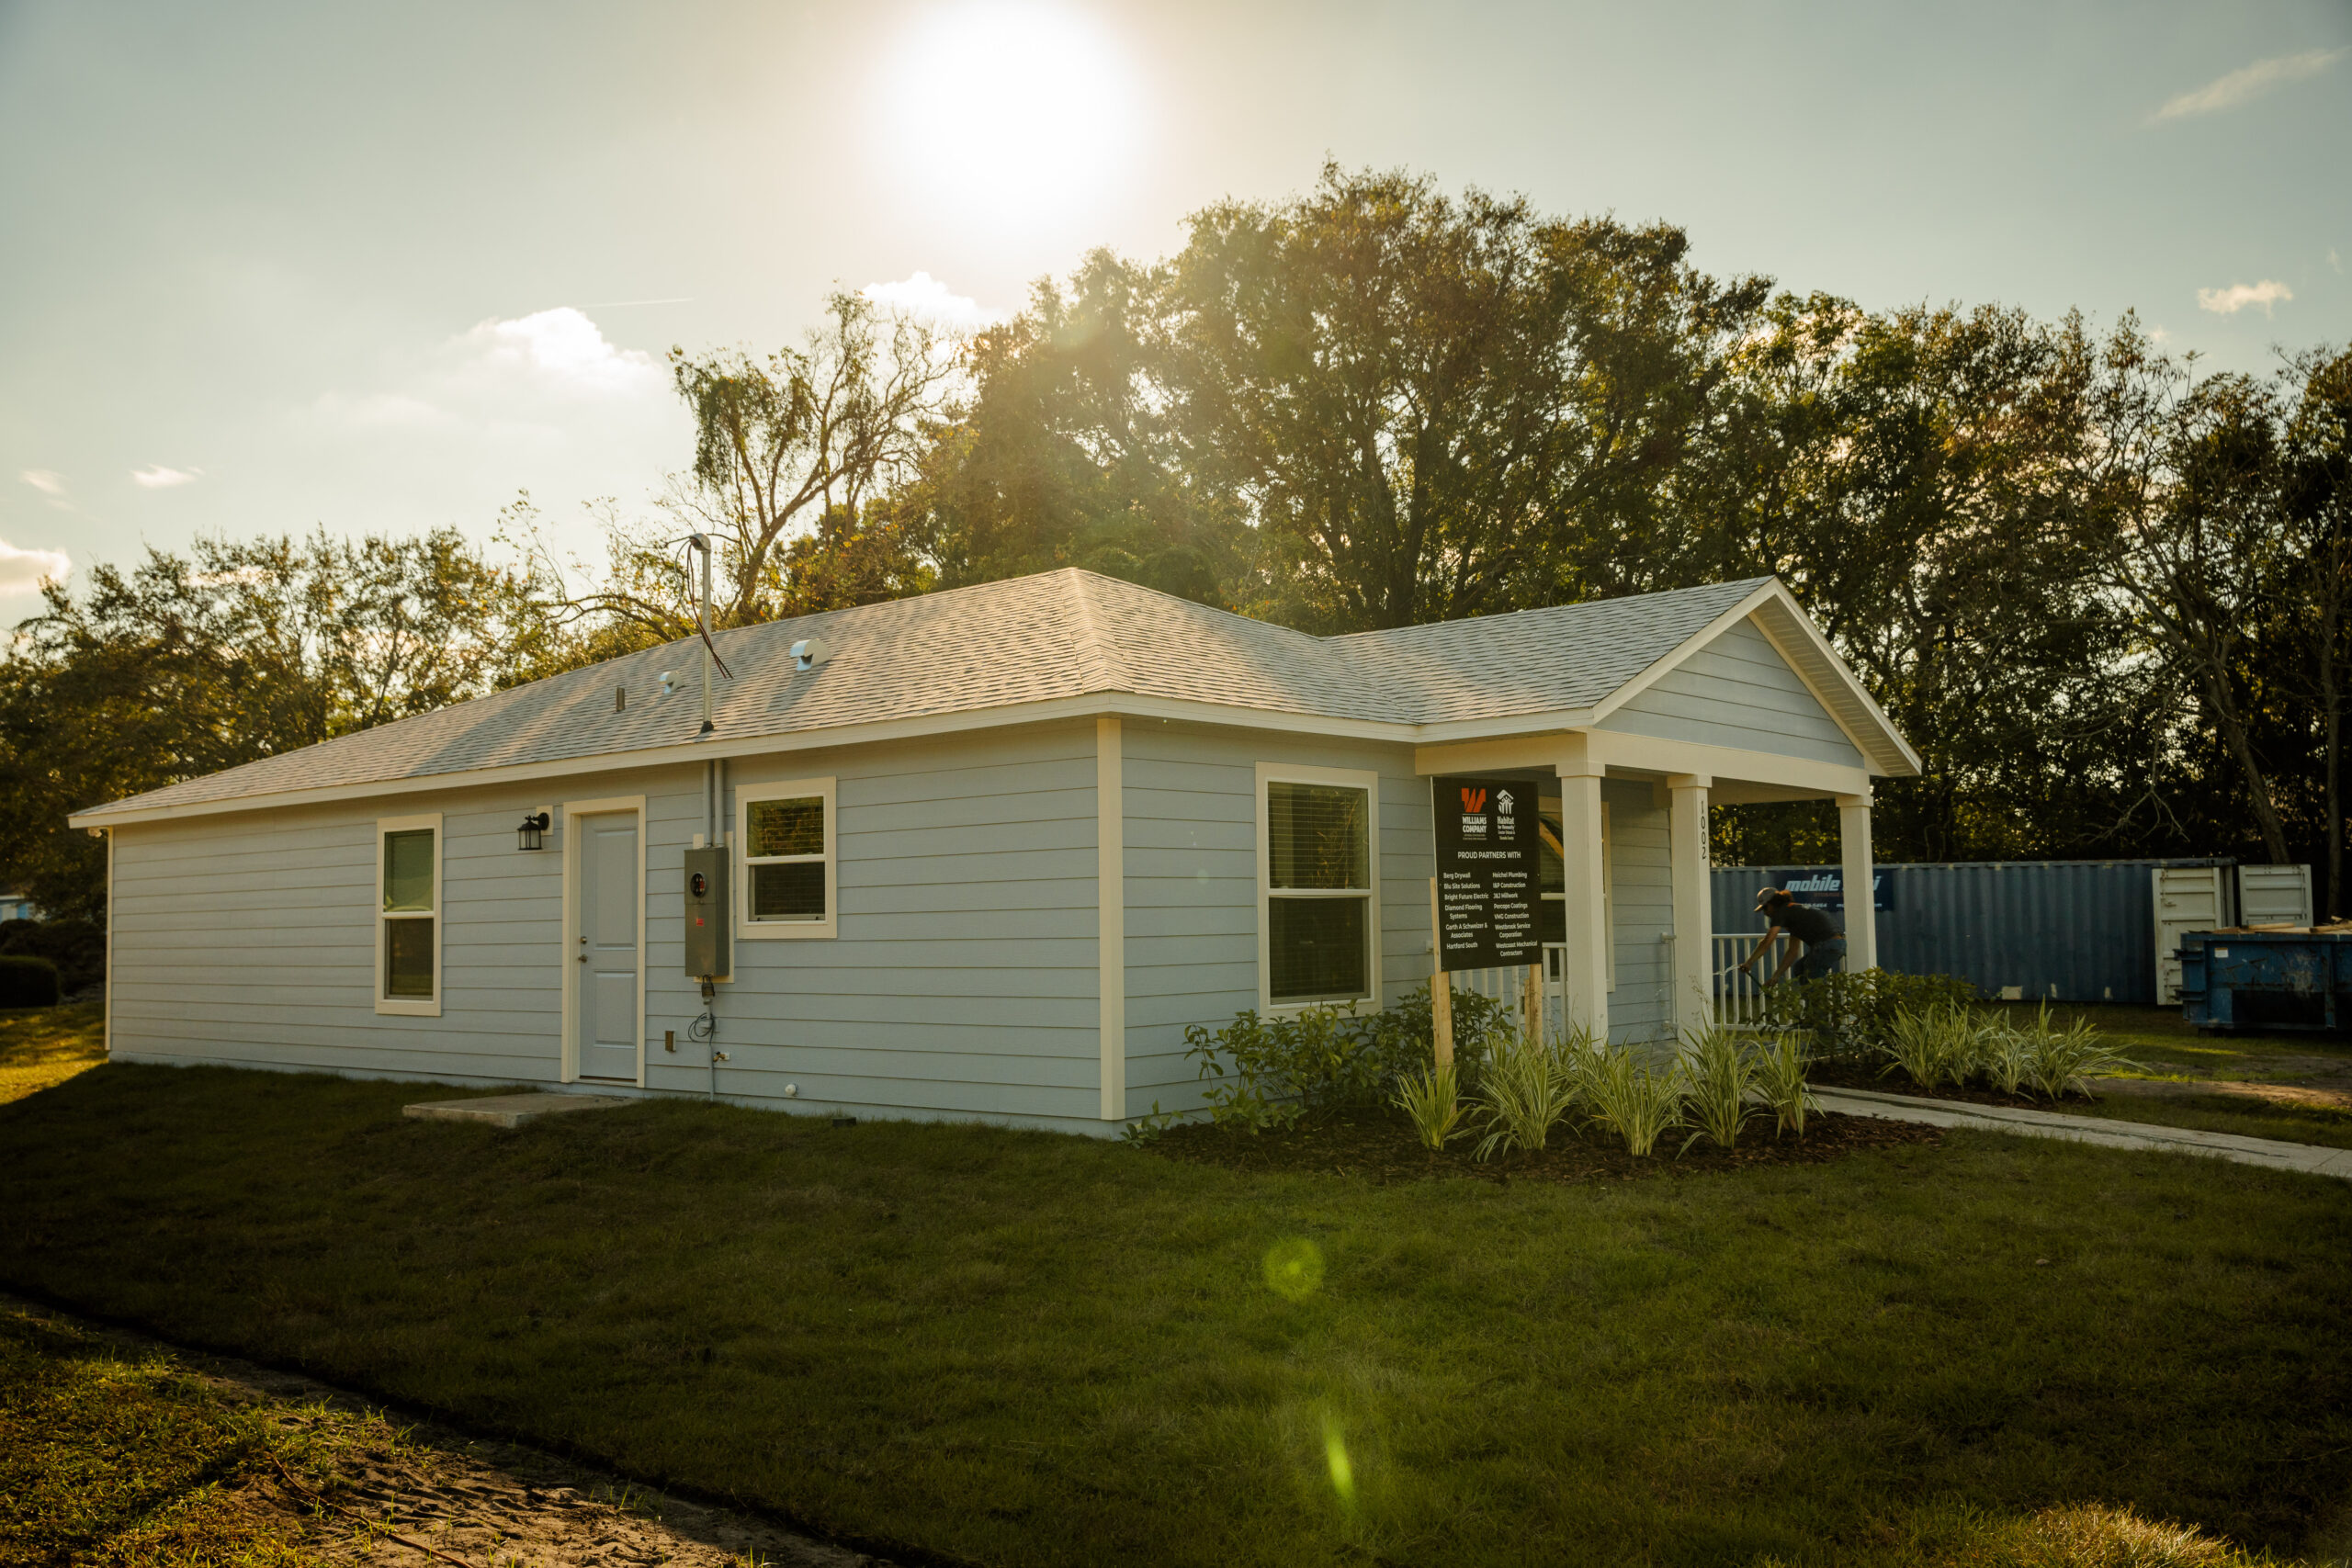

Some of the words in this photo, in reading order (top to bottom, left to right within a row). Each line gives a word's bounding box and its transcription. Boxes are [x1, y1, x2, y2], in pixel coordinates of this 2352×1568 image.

[1463, 816, 1487, 824] WILLIAMS
[1497, 816, 1514, 824] Habitat
[1463, 825, 1487, 833] COMPANY
[1454, 872, 1471, 880] Drywall
[1509, 871, 1527, 879] Plumbing
[1785, 874, 1840, 891] mobile
[1464, 903, 1482, 911] Flooring
